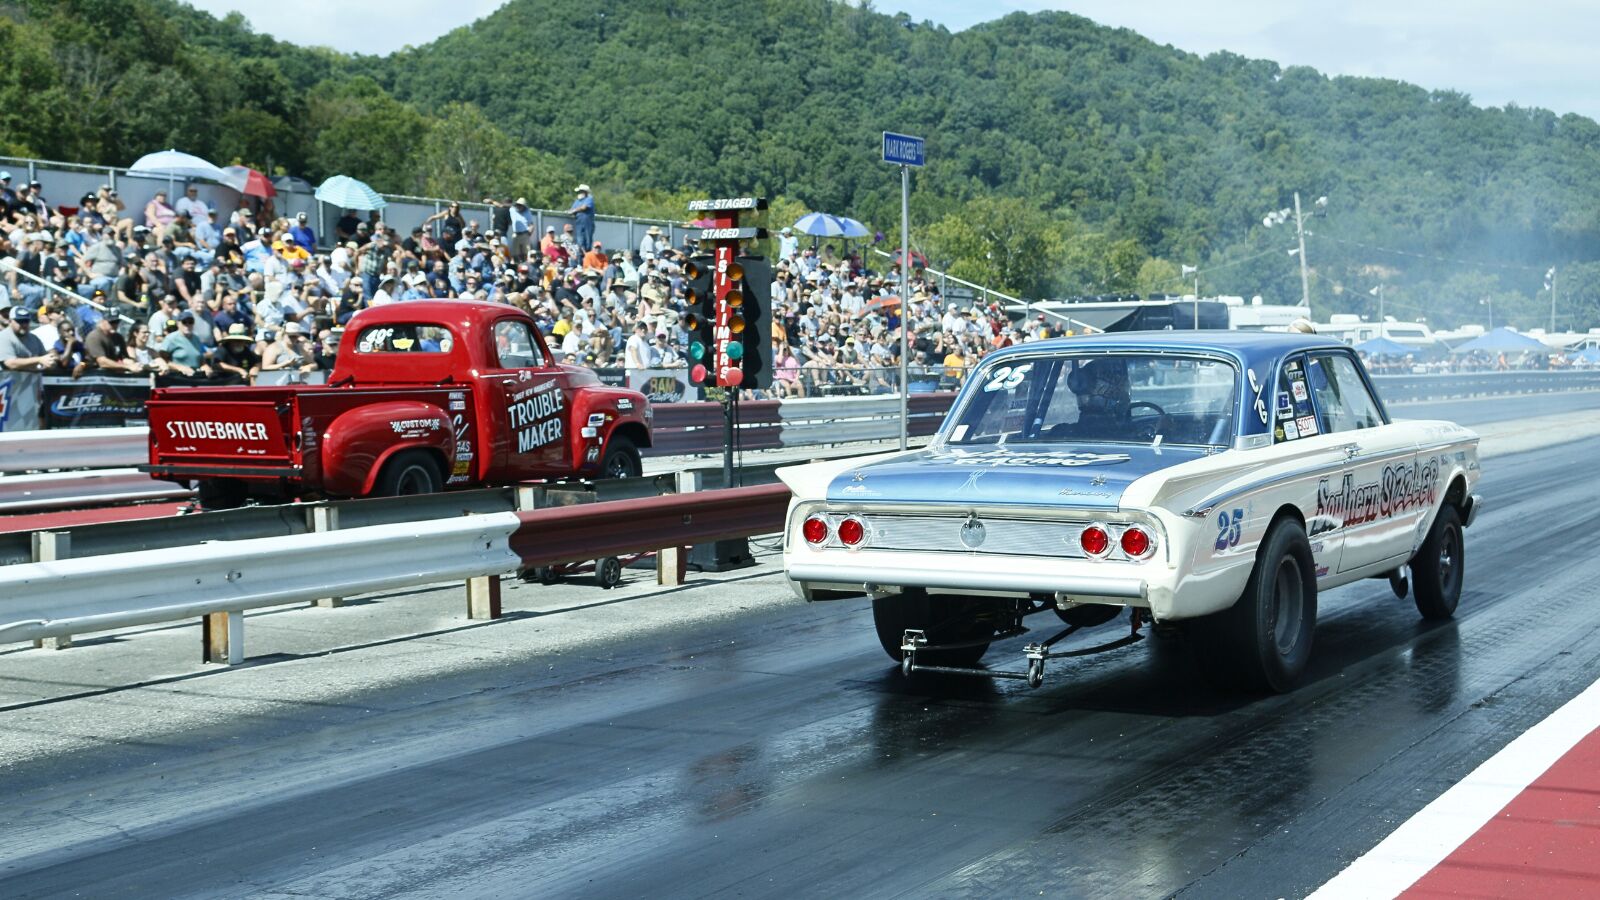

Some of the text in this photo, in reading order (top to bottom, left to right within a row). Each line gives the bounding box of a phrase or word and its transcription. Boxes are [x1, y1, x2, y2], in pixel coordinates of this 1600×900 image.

[886, 138, 899, 158] MARK
[900, 140, 916, 160] ROGERS
[689, 198, 752, 210] PRE-STAGED
[701, 229, 739, 239] STAGED
[984, 362, 1034, 392] 25
[508, 388, 563, 429] TROUBLE
[1248, 369, 1267, 424] C/G
[166, 421, 268, 440] STUDEBAKER
[401, 419, 431, 428] CUSTOM
[518, 418, 562, 453] MAKER
[1314, 470, 1379, 530] Southern
[1213, 508, 1244, 551] 25
